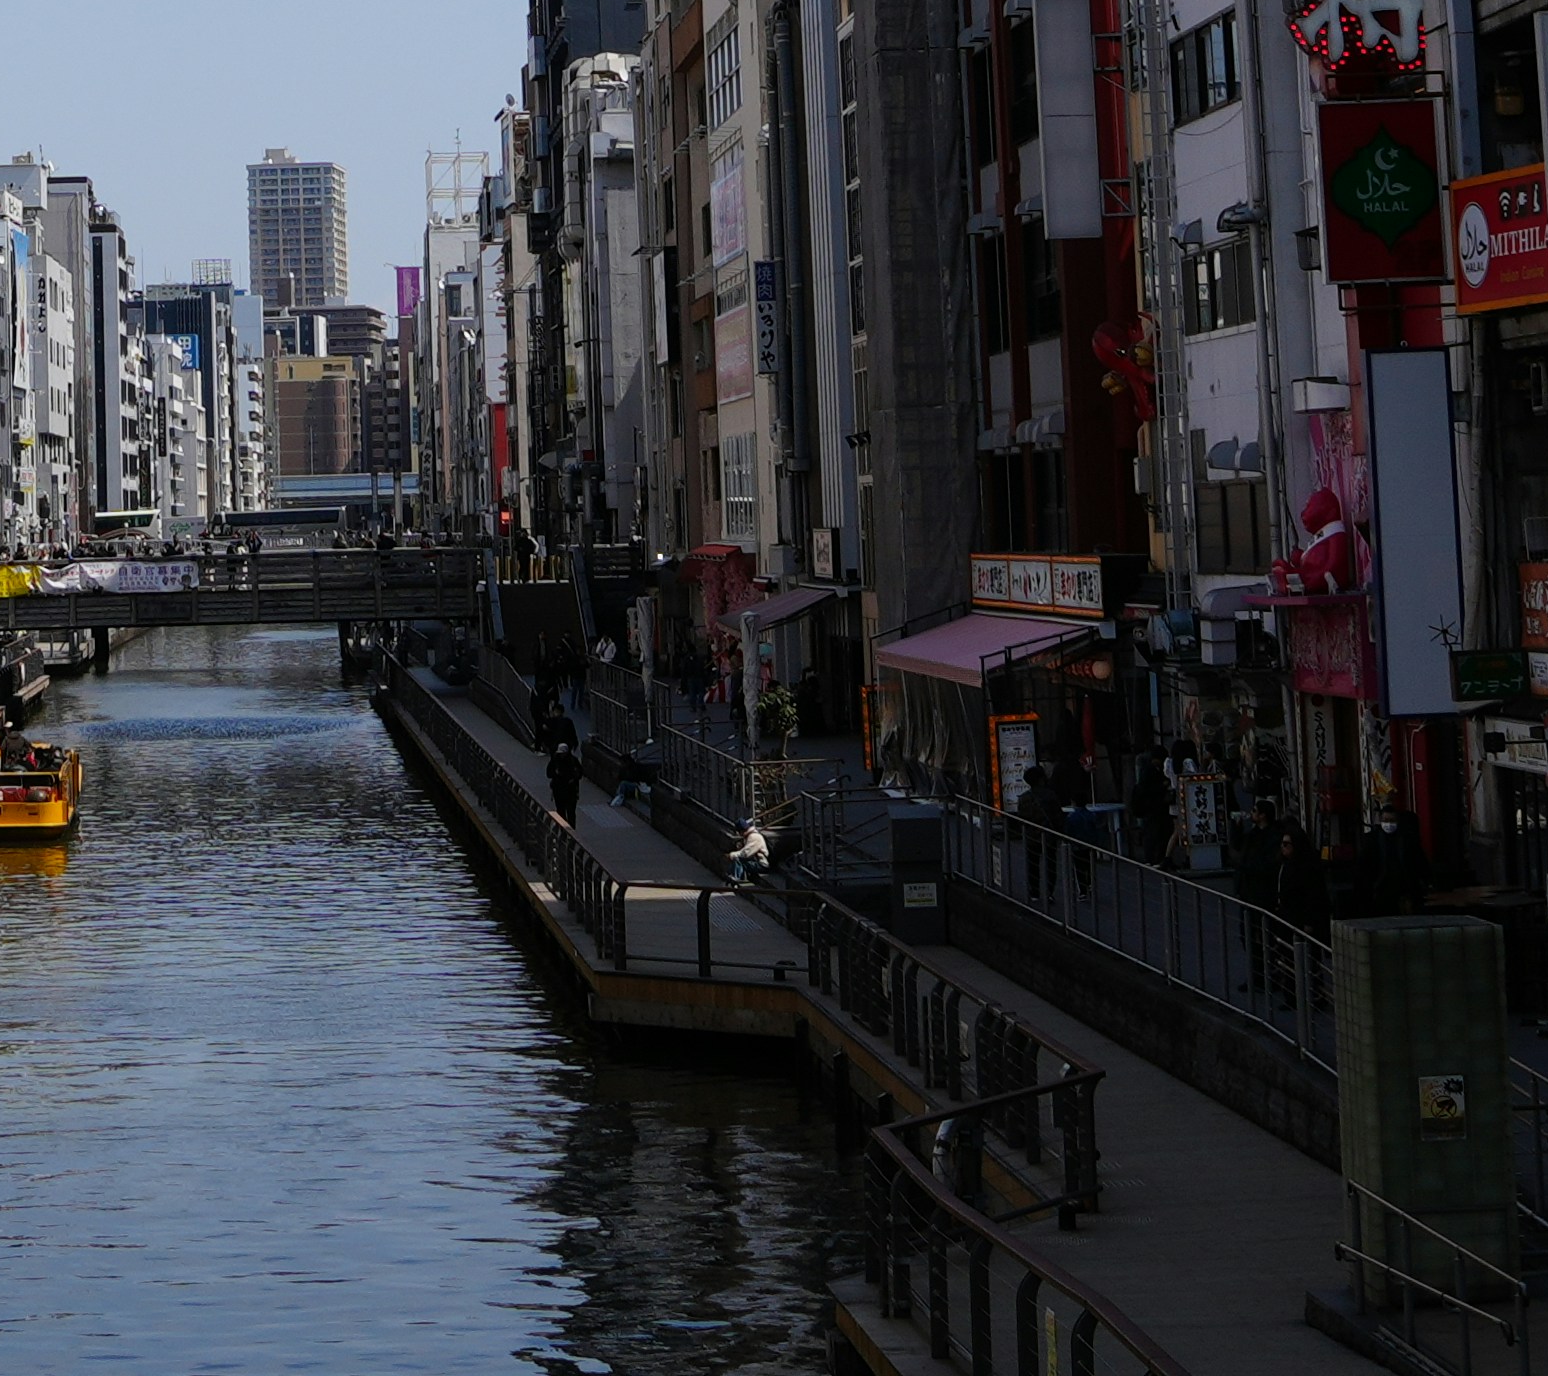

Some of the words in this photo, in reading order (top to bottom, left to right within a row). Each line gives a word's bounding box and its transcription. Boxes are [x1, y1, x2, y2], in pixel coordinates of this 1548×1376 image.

[1363, 199, 1411, 214] HALAL
[1465, 261, 1486, 274] HALAL
[756, 266, 776, 301] 焼肉
[757, 303, 777, 372] いろりや
[118, 565, 194, 578] 自衛官募集中
